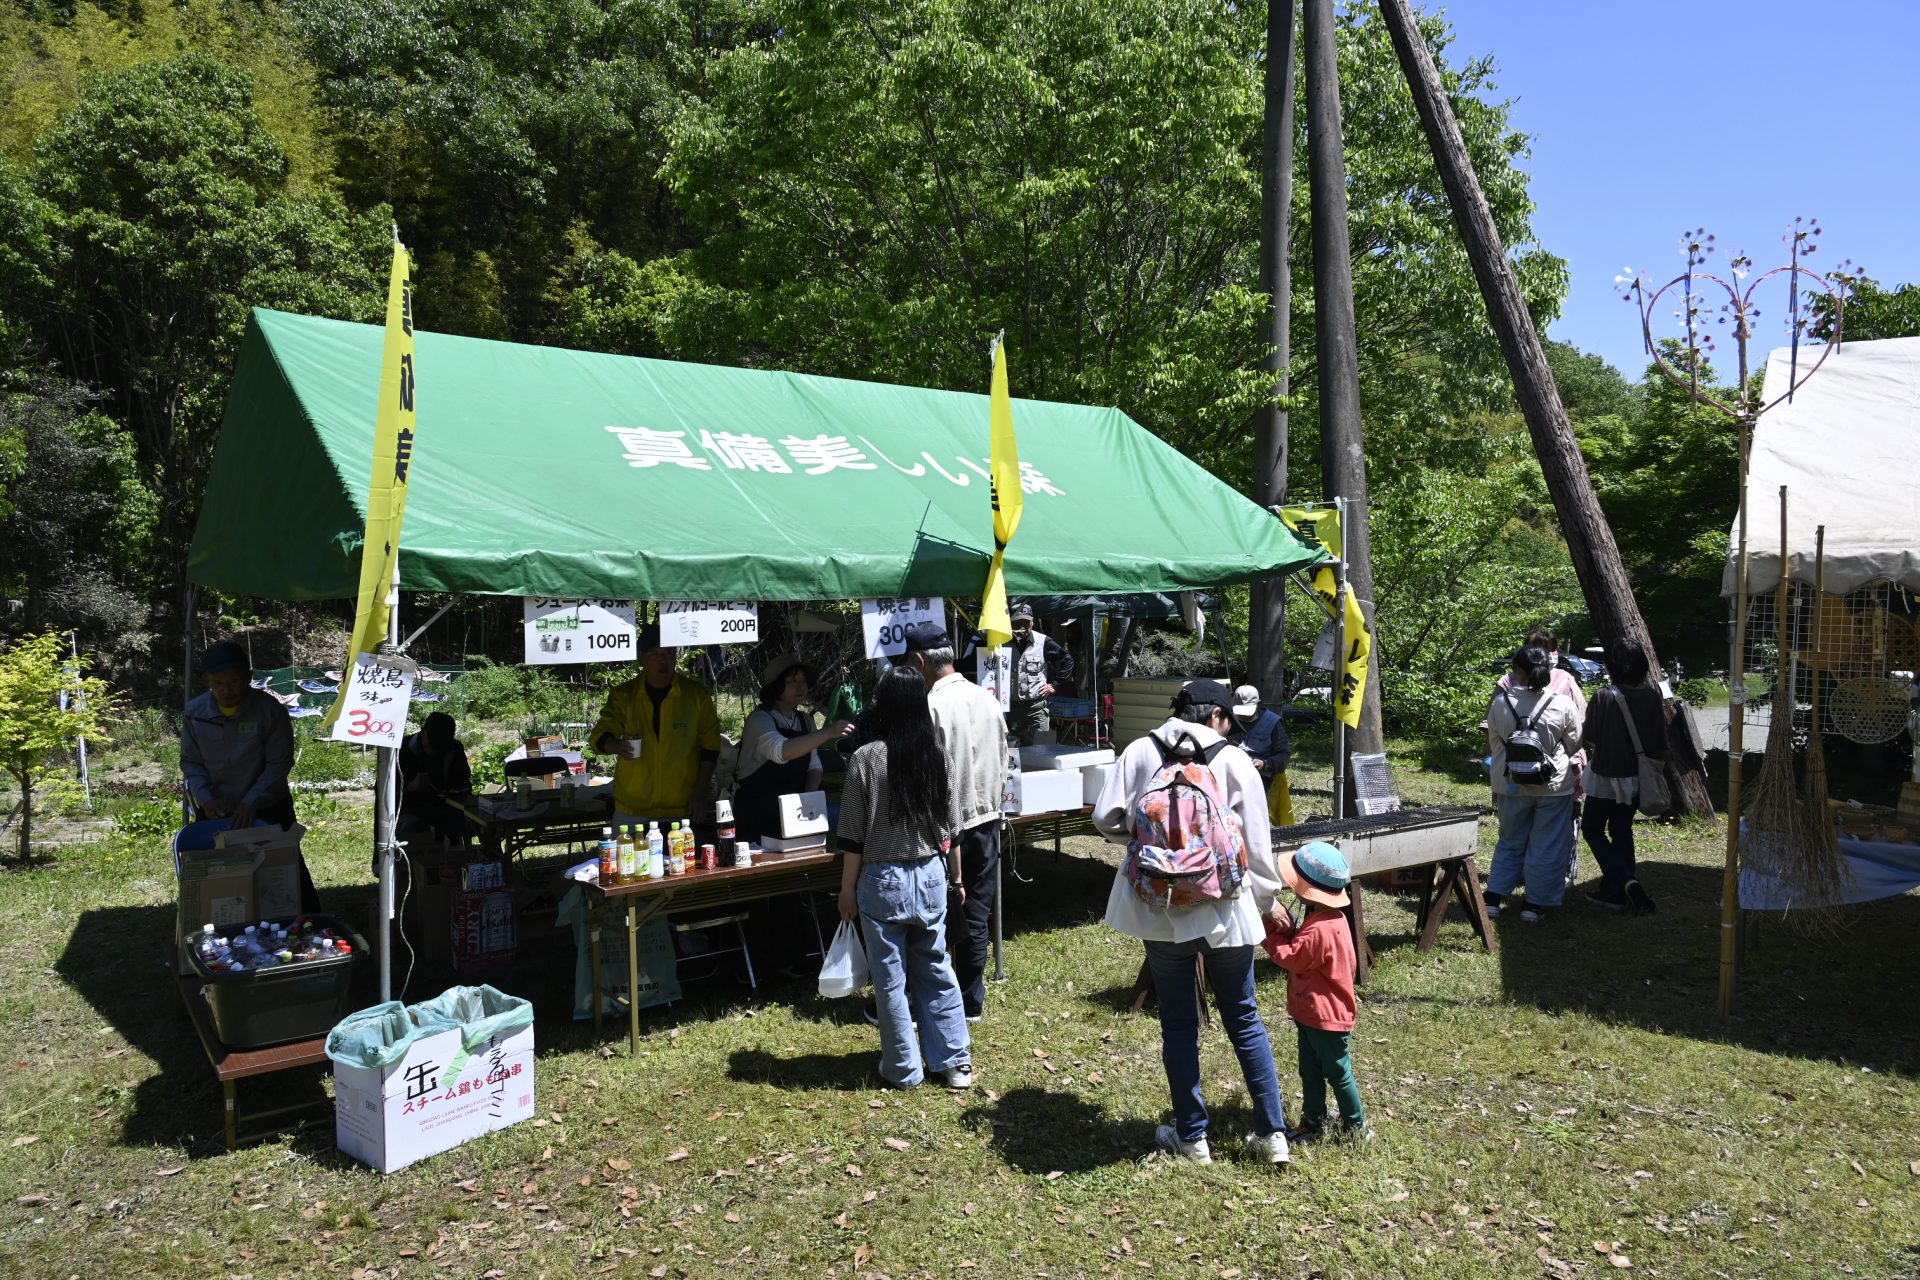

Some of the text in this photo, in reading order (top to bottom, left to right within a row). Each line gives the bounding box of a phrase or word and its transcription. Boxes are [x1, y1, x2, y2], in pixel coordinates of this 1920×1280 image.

[720, 619, 755, 632] 200円
[587, 633, 630, 649] 100円
[357, 663, 406, 689] 焼鳥
[403, 1060, 440, 1100] 缶
